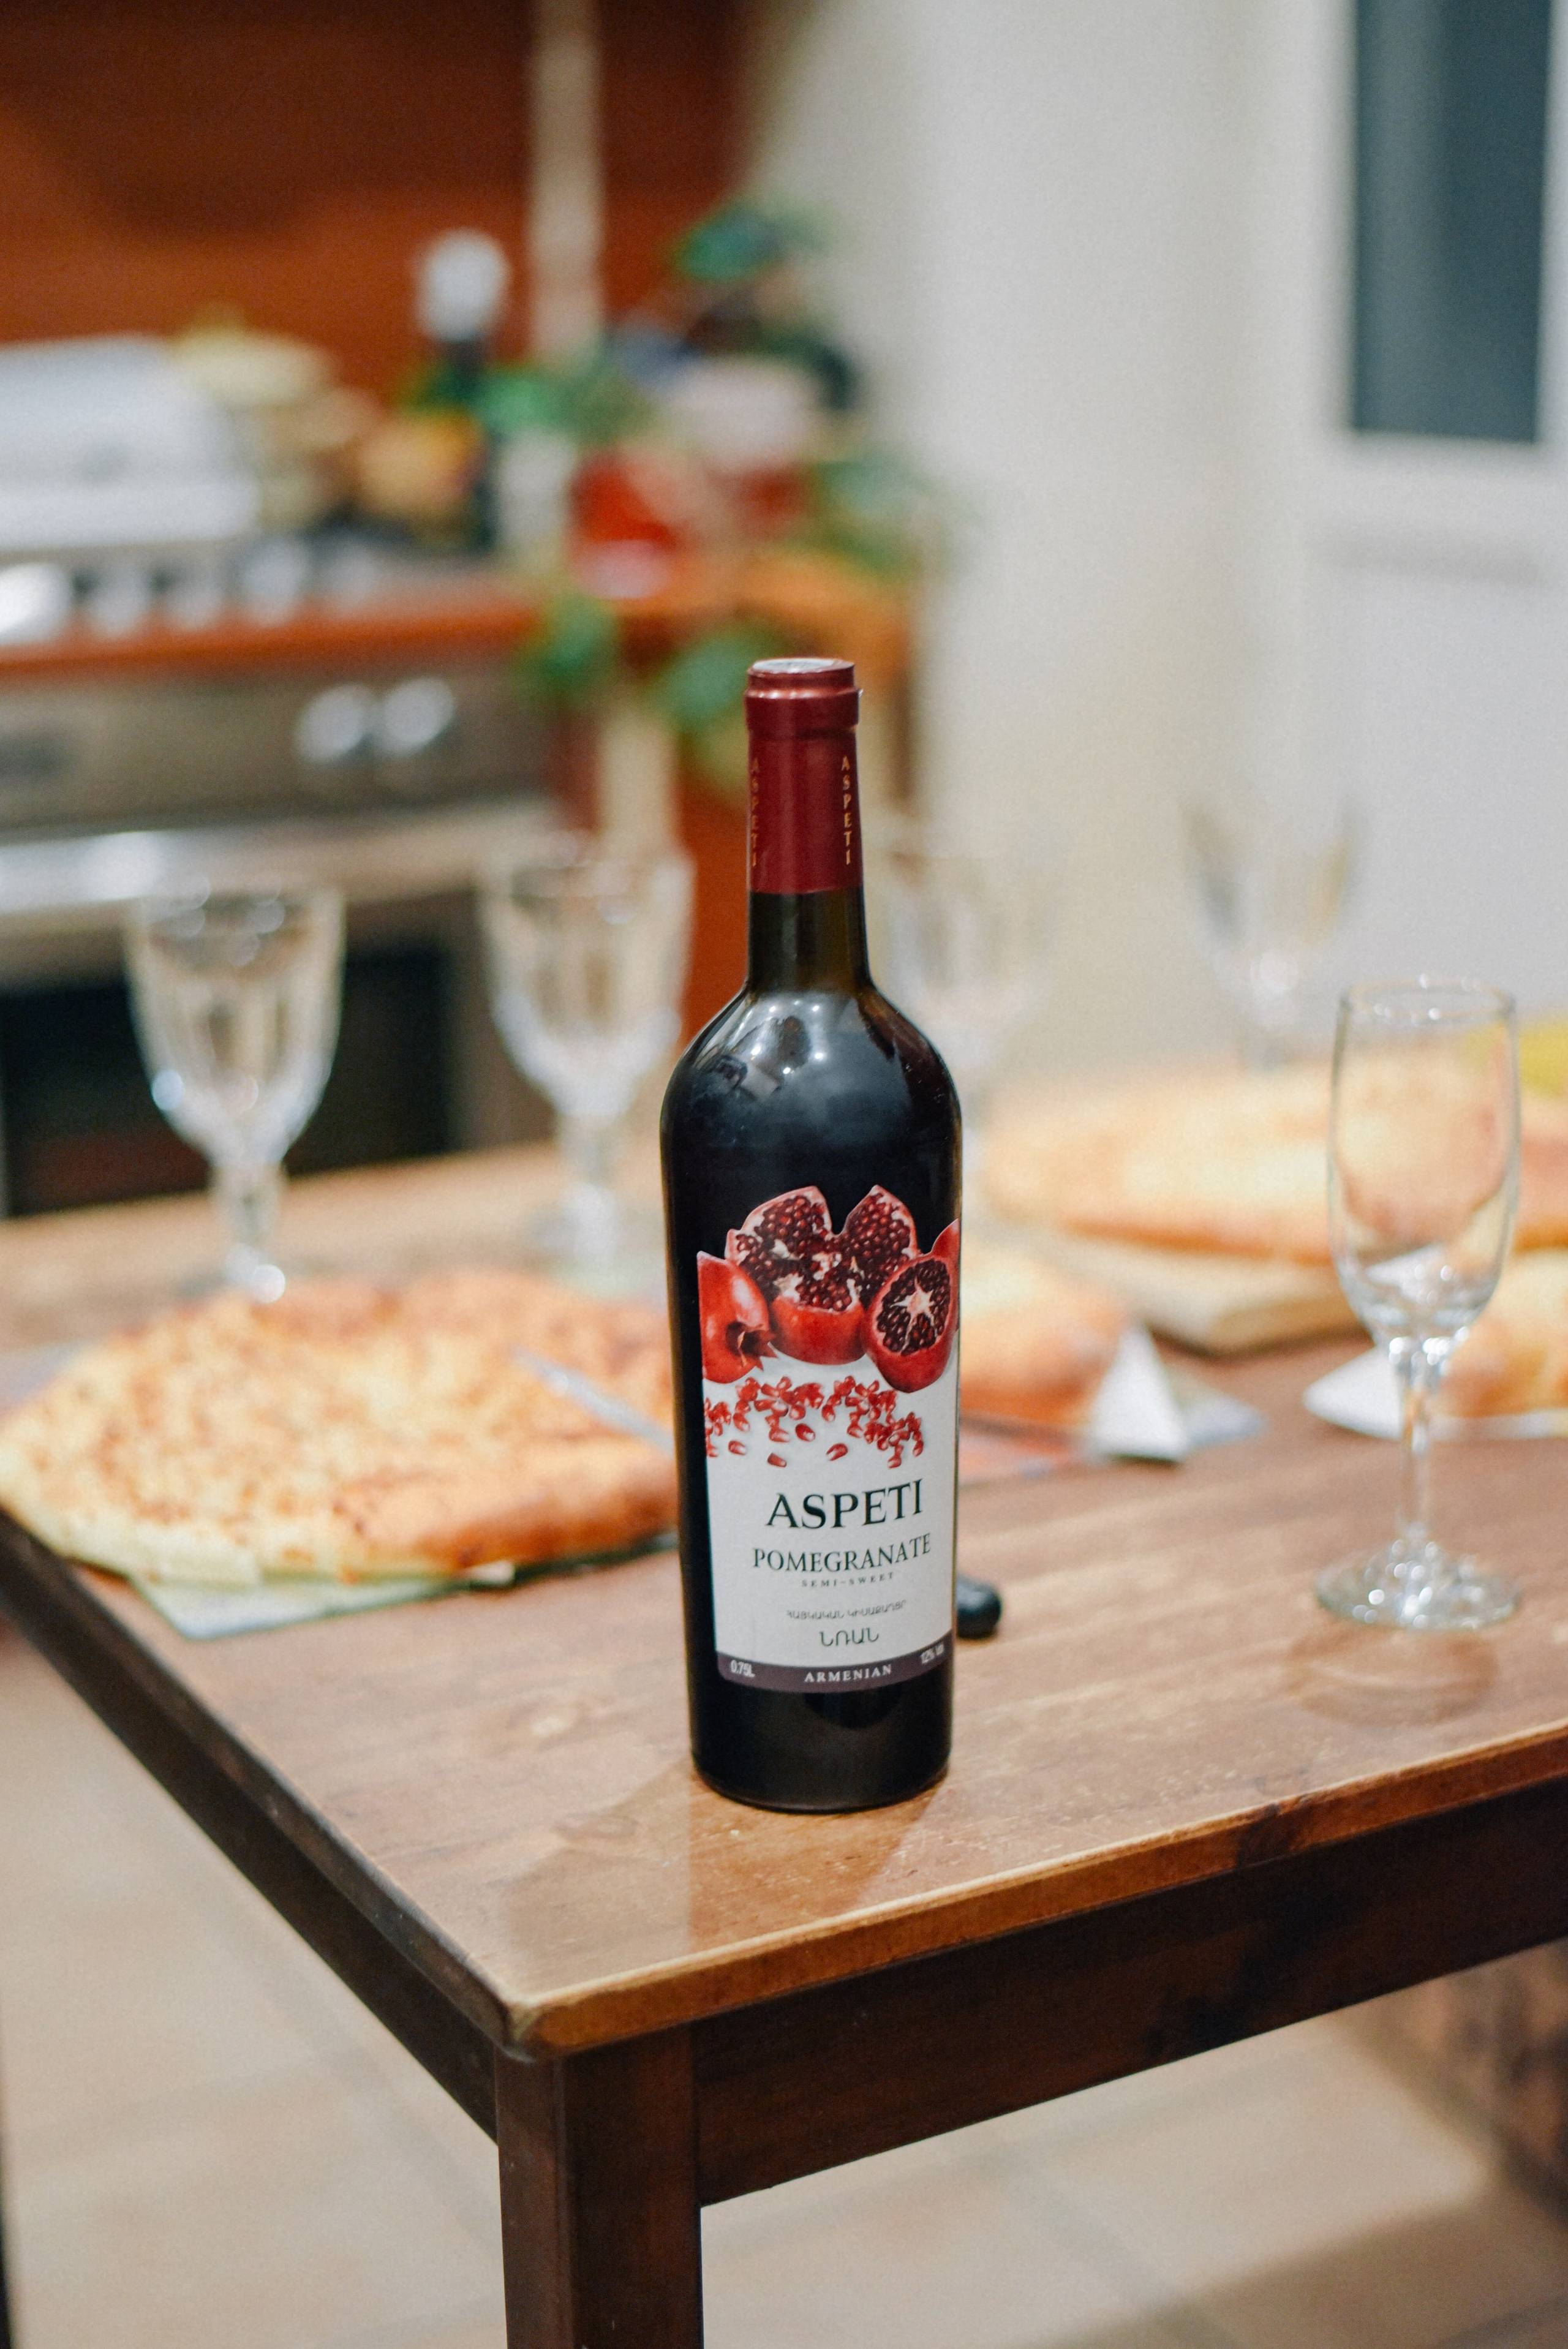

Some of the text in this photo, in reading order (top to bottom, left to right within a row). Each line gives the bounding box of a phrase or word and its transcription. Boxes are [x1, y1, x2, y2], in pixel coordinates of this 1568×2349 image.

[842, 756, 851, 865] ASPETI
[766, 1479, 922, 1529] ASPETI
[752, 1533, 930, 1572] POMEGRANATE
[801, 1572, 894, 1588] SEMI-SWEET
[819, 1627, 880, 1647] ՆՌԱՆ
[730, 1659, 755, 1678] 0.75L
[804, 1664, 892, 1683] ARMENIAN
